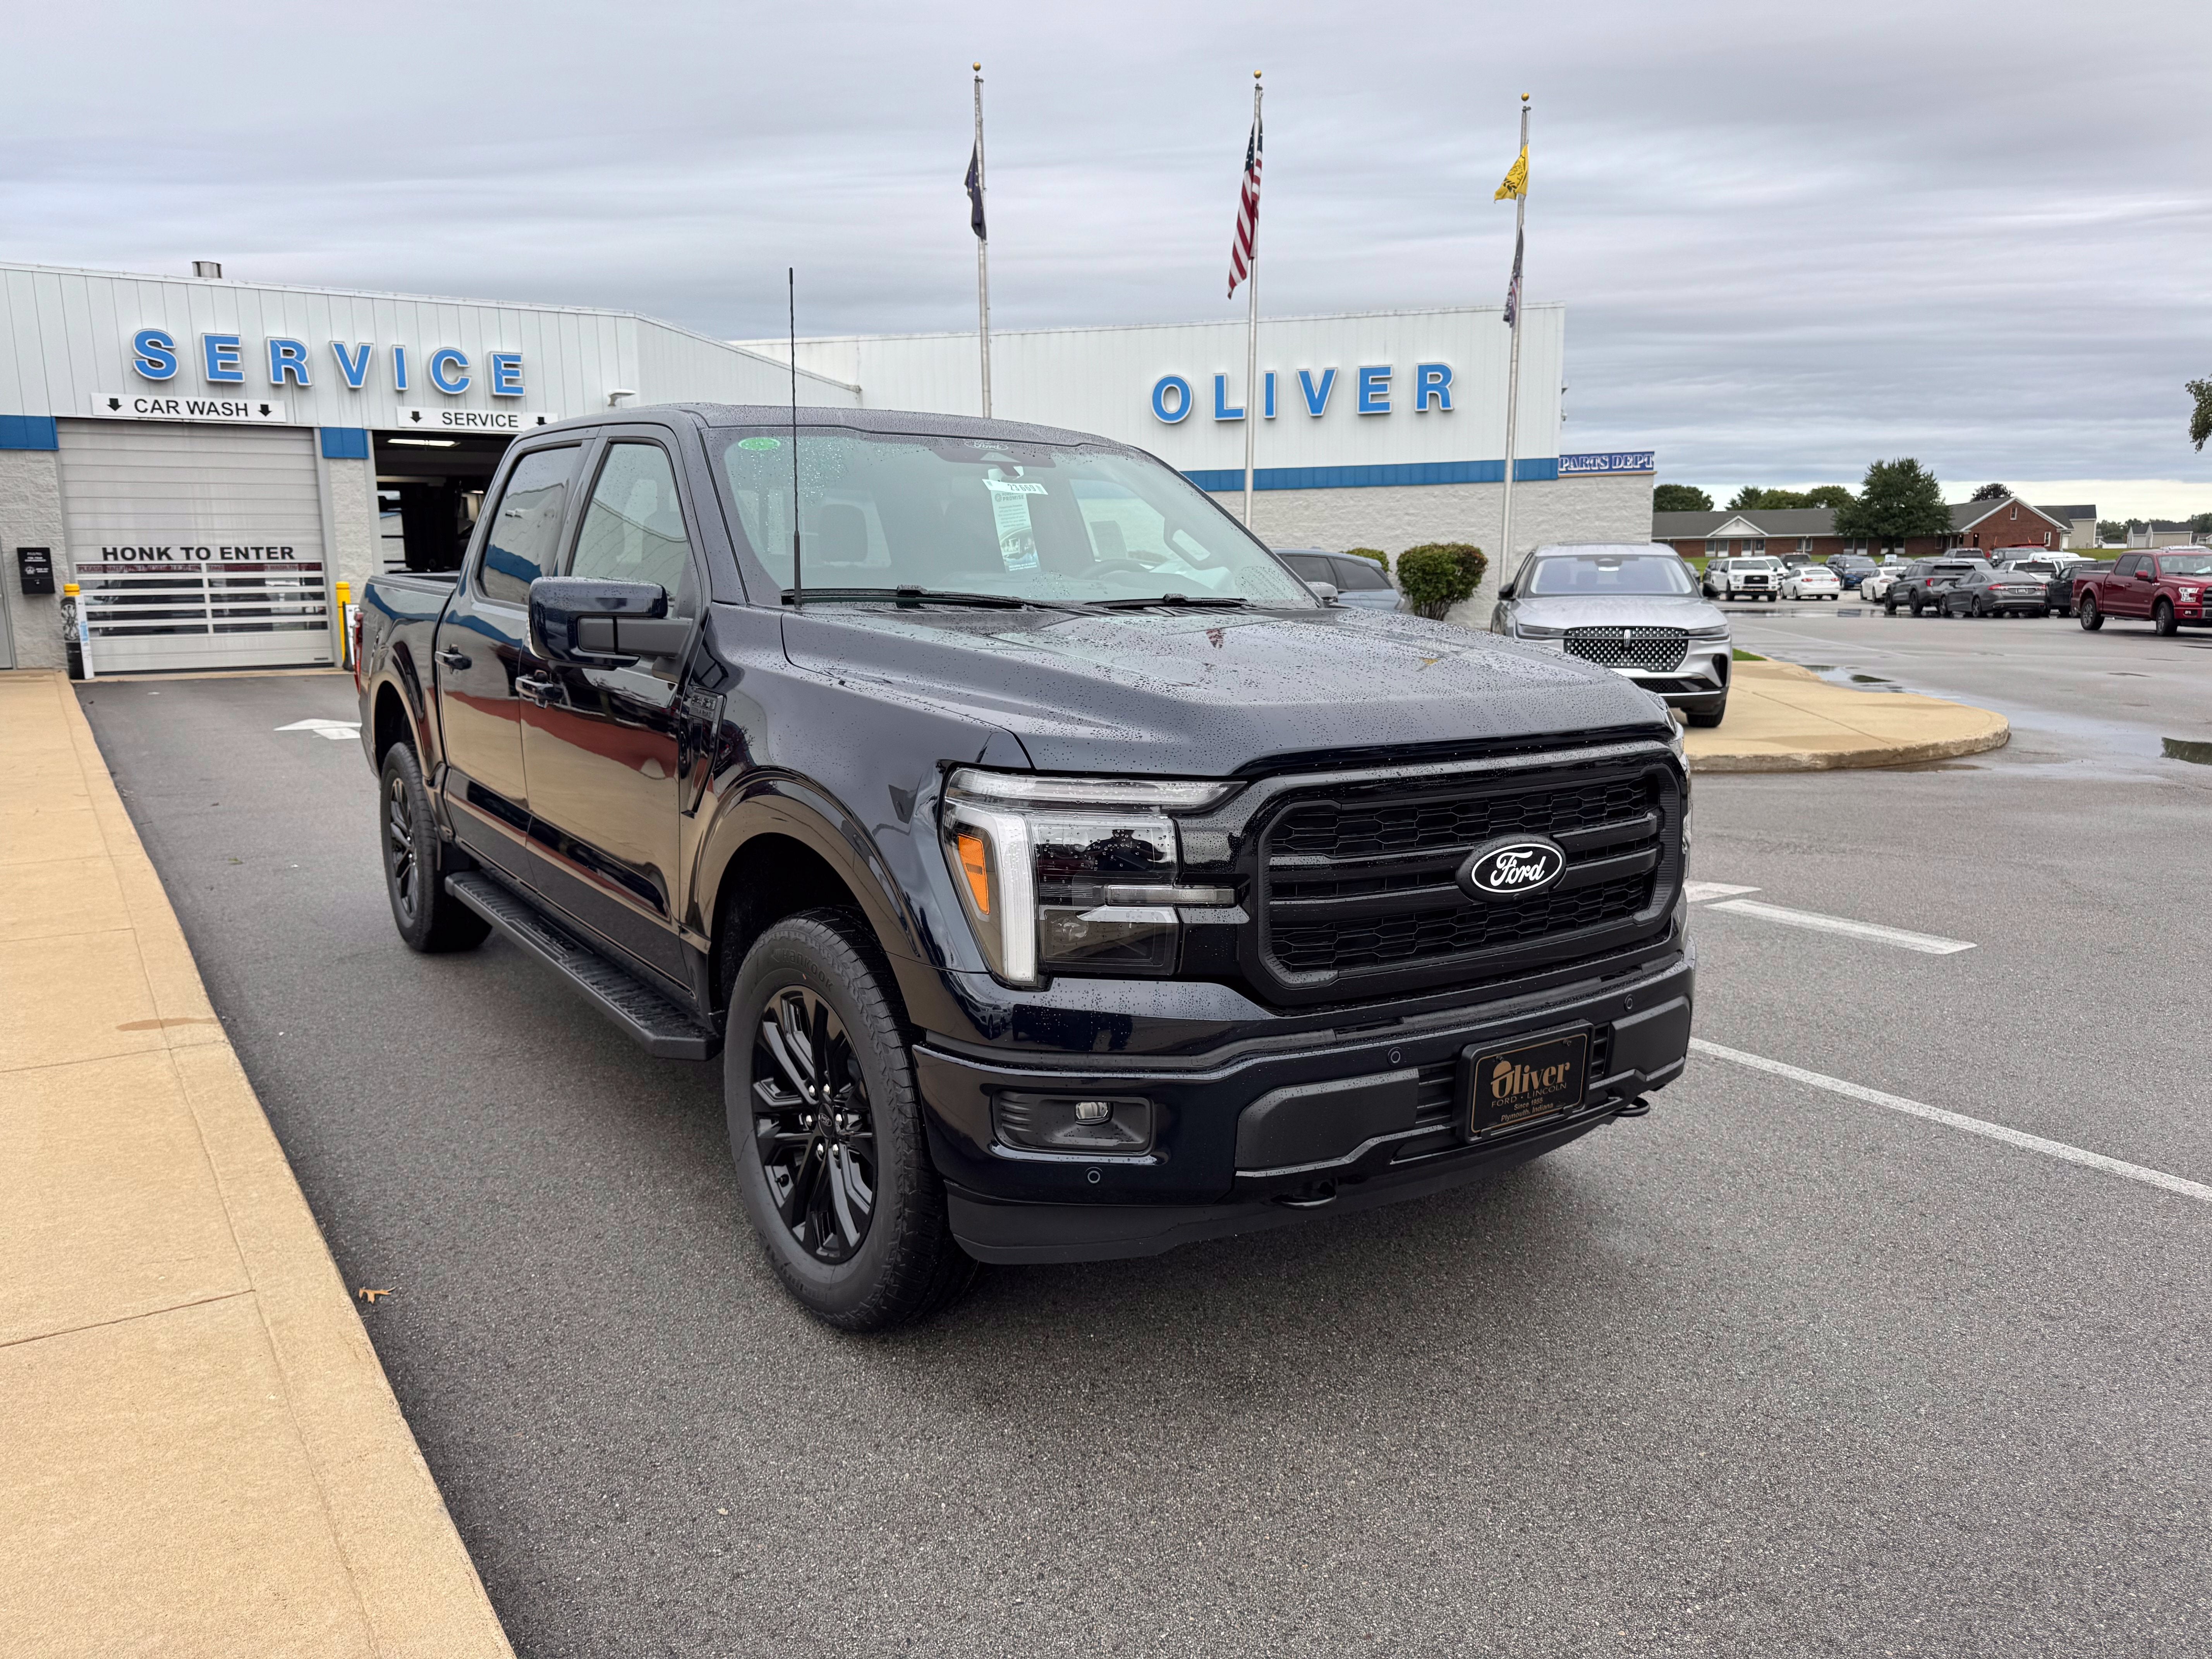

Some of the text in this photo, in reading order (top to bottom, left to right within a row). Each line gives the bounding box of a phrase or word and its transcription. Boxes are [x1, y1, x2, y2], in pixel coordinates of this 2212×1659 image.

[132, 328, 527, 397] SERVICE
[1150, 362, 1455, 424] OLIVER
[134, 398, 248, 417] CAR WASH
[442, 411, 518, 428] SERVICE
[1559, 455, 1654, 471] PARTS DEPT
[103, 547, 295, 561] HONK TO ENTER
[1490, 850, 1546, 886] Ford
[1491, 1060, 1570, 1099] Oliver
[1491, 1082, 1567, 1108] FORD LINCOLN
[1514, 1102, 1529, 1111] Since
[1532, 1103, 1553, 1114] Indiana
